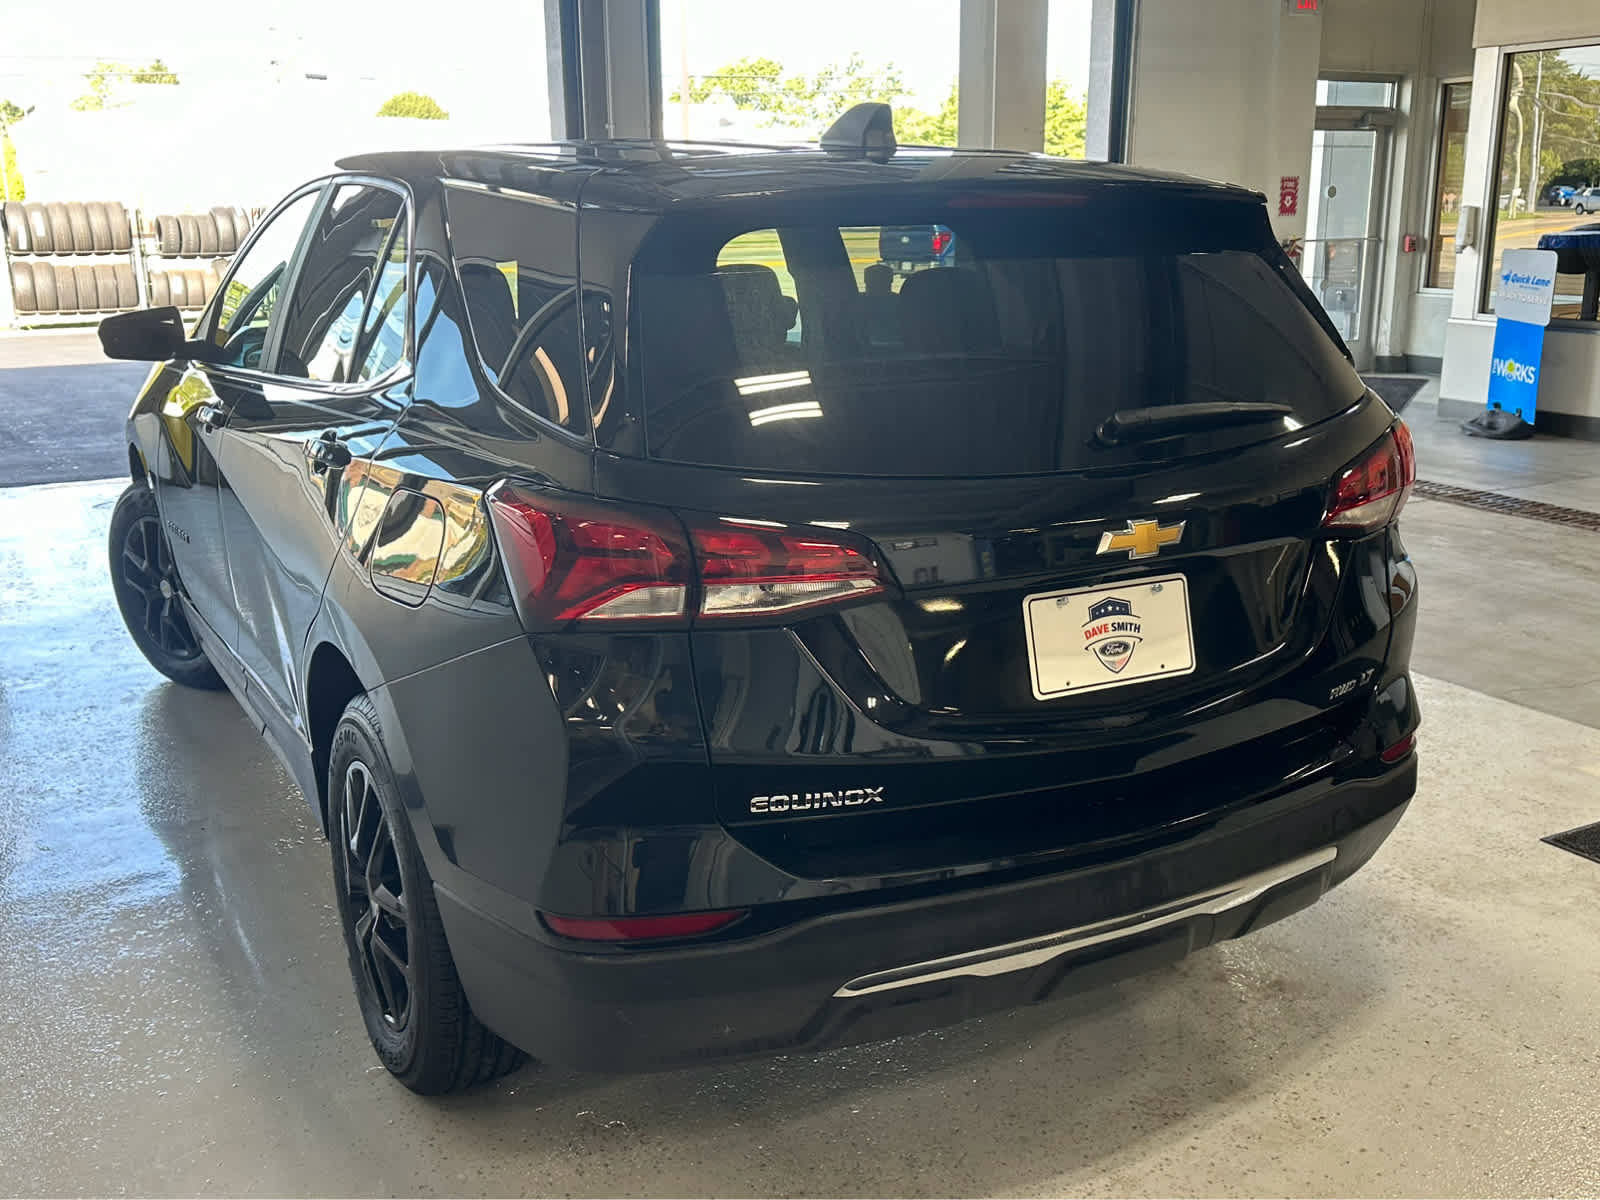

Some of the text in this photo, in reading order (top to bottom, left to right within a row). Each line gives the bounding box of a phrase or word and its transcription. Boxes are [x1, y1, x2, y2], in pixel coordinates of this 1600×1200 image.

[1511, 273, 1530, 284] Quick
[1531, 275, 1551, 287] Lane
[1083, 621, 1141, 640] DAVE SMITH
[750, 786, 884, 813] EQUINOX
